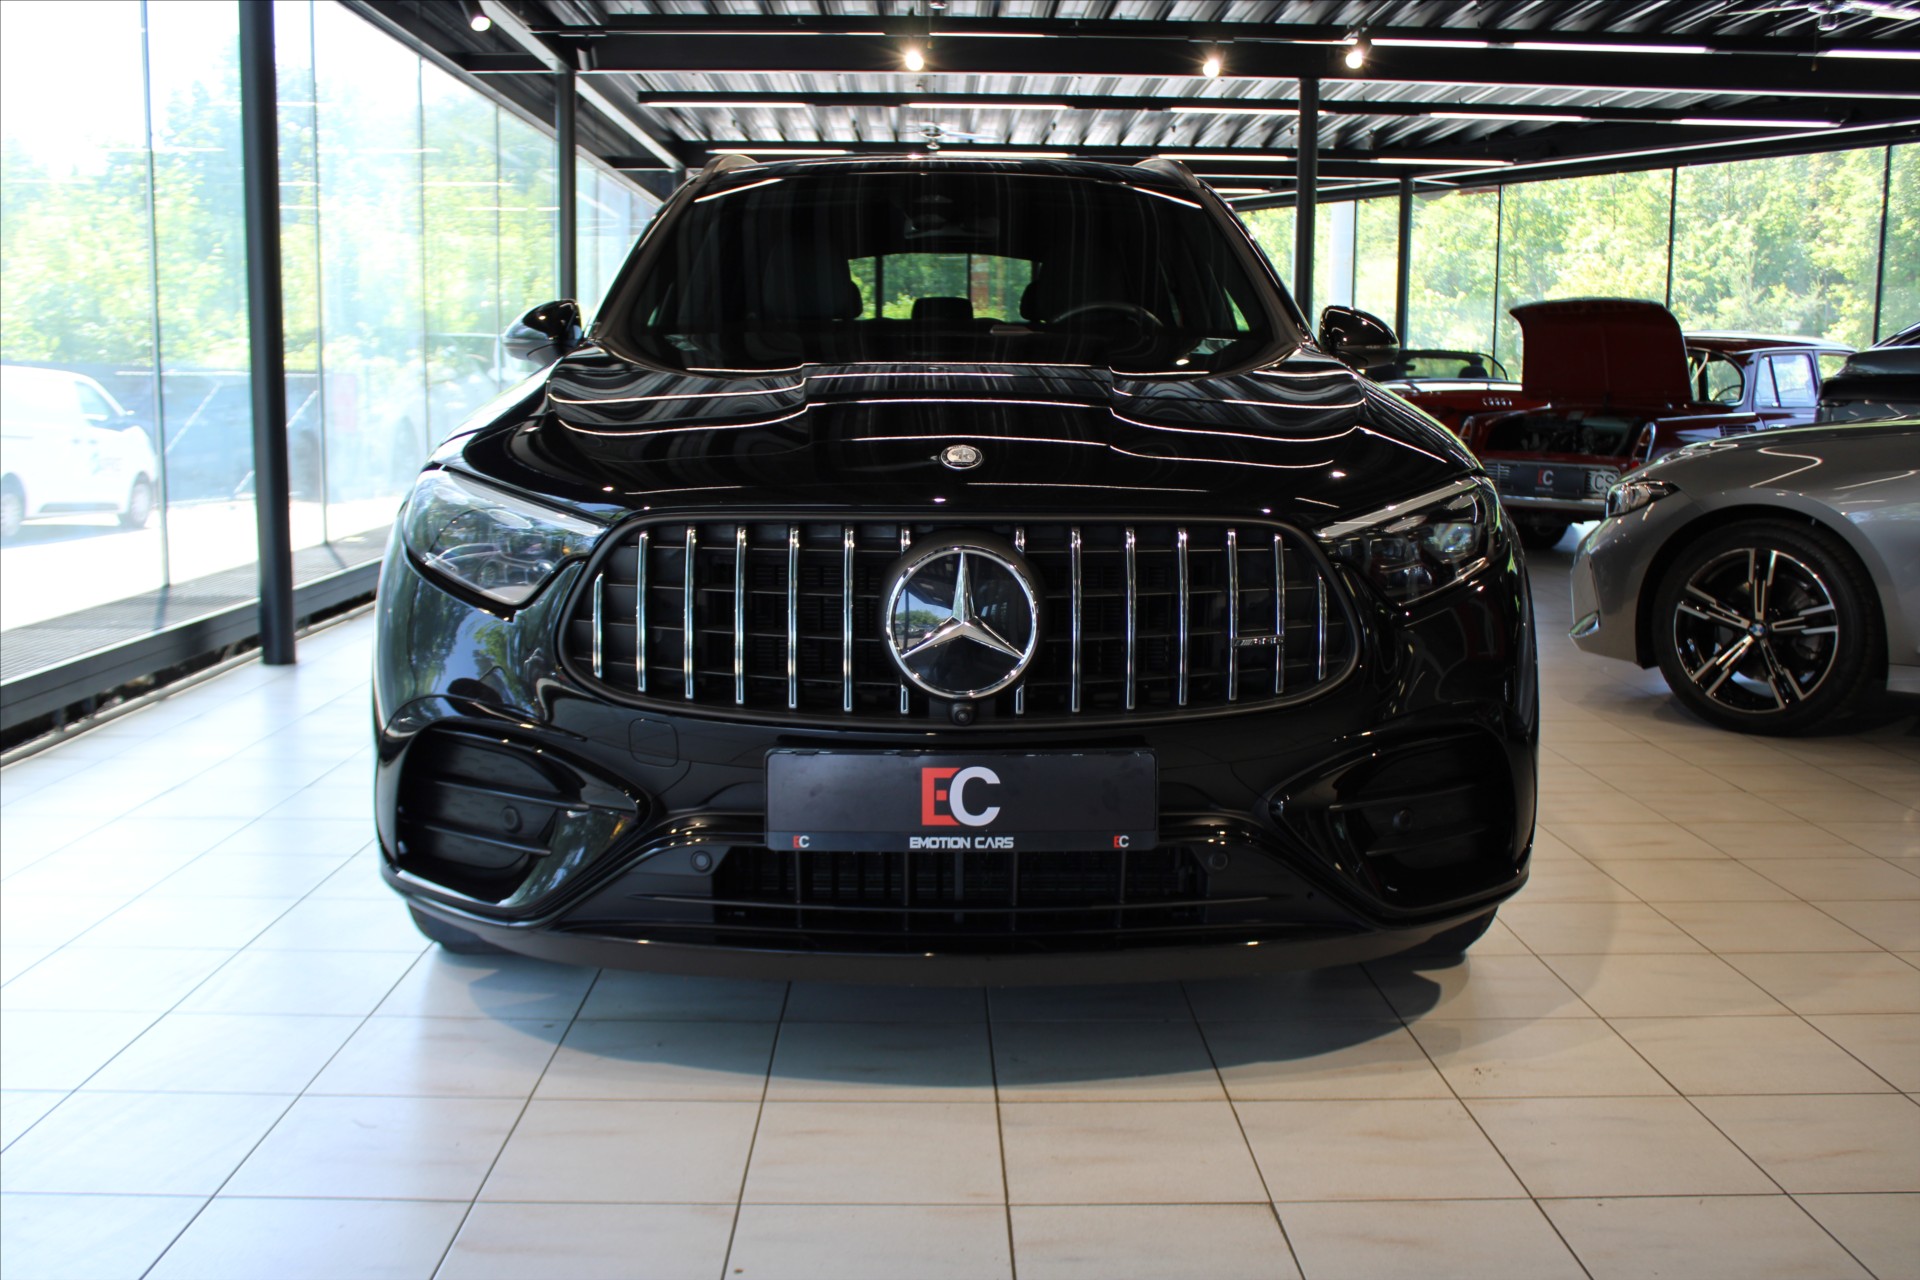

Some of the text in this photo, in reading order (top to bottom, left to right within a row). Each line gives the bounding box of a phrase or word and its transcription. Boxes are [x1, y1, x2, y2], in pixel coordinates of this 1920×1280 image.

[921, 766, 1001, 827] EC
[793, 835, 810, 849] EC
[909, 836, 1014, 849] EMOTION CARS
[1113, 835, 1130, 849] EC
